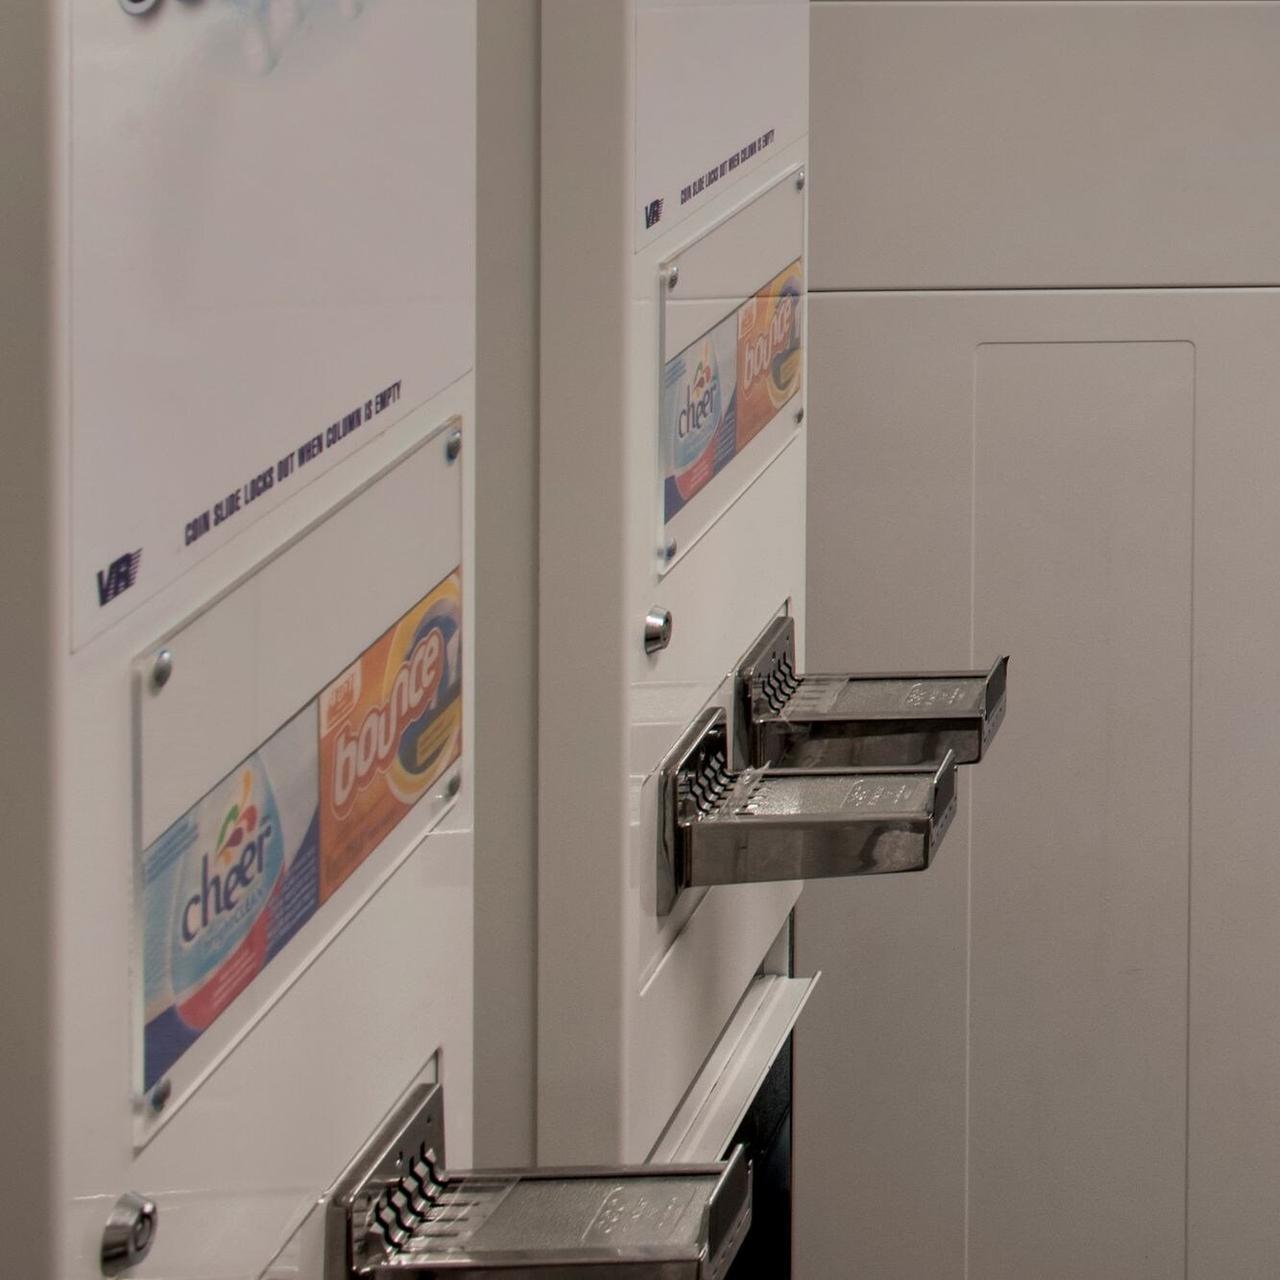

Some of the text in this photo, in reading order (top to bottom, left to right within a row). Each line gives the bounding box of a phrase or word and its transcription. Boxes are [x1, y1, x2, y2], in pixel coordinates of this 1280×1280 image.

[744, 297, 793, 389] bounce
[185, 379, 401, 547] COIN SLIDE LOCKS OUT WHEN COLUMN IS EMPTY
[678, 383, 717, 438] cheer
[335, 631, 441, 810] bounce
[181, 819, 273, 943] cheer
